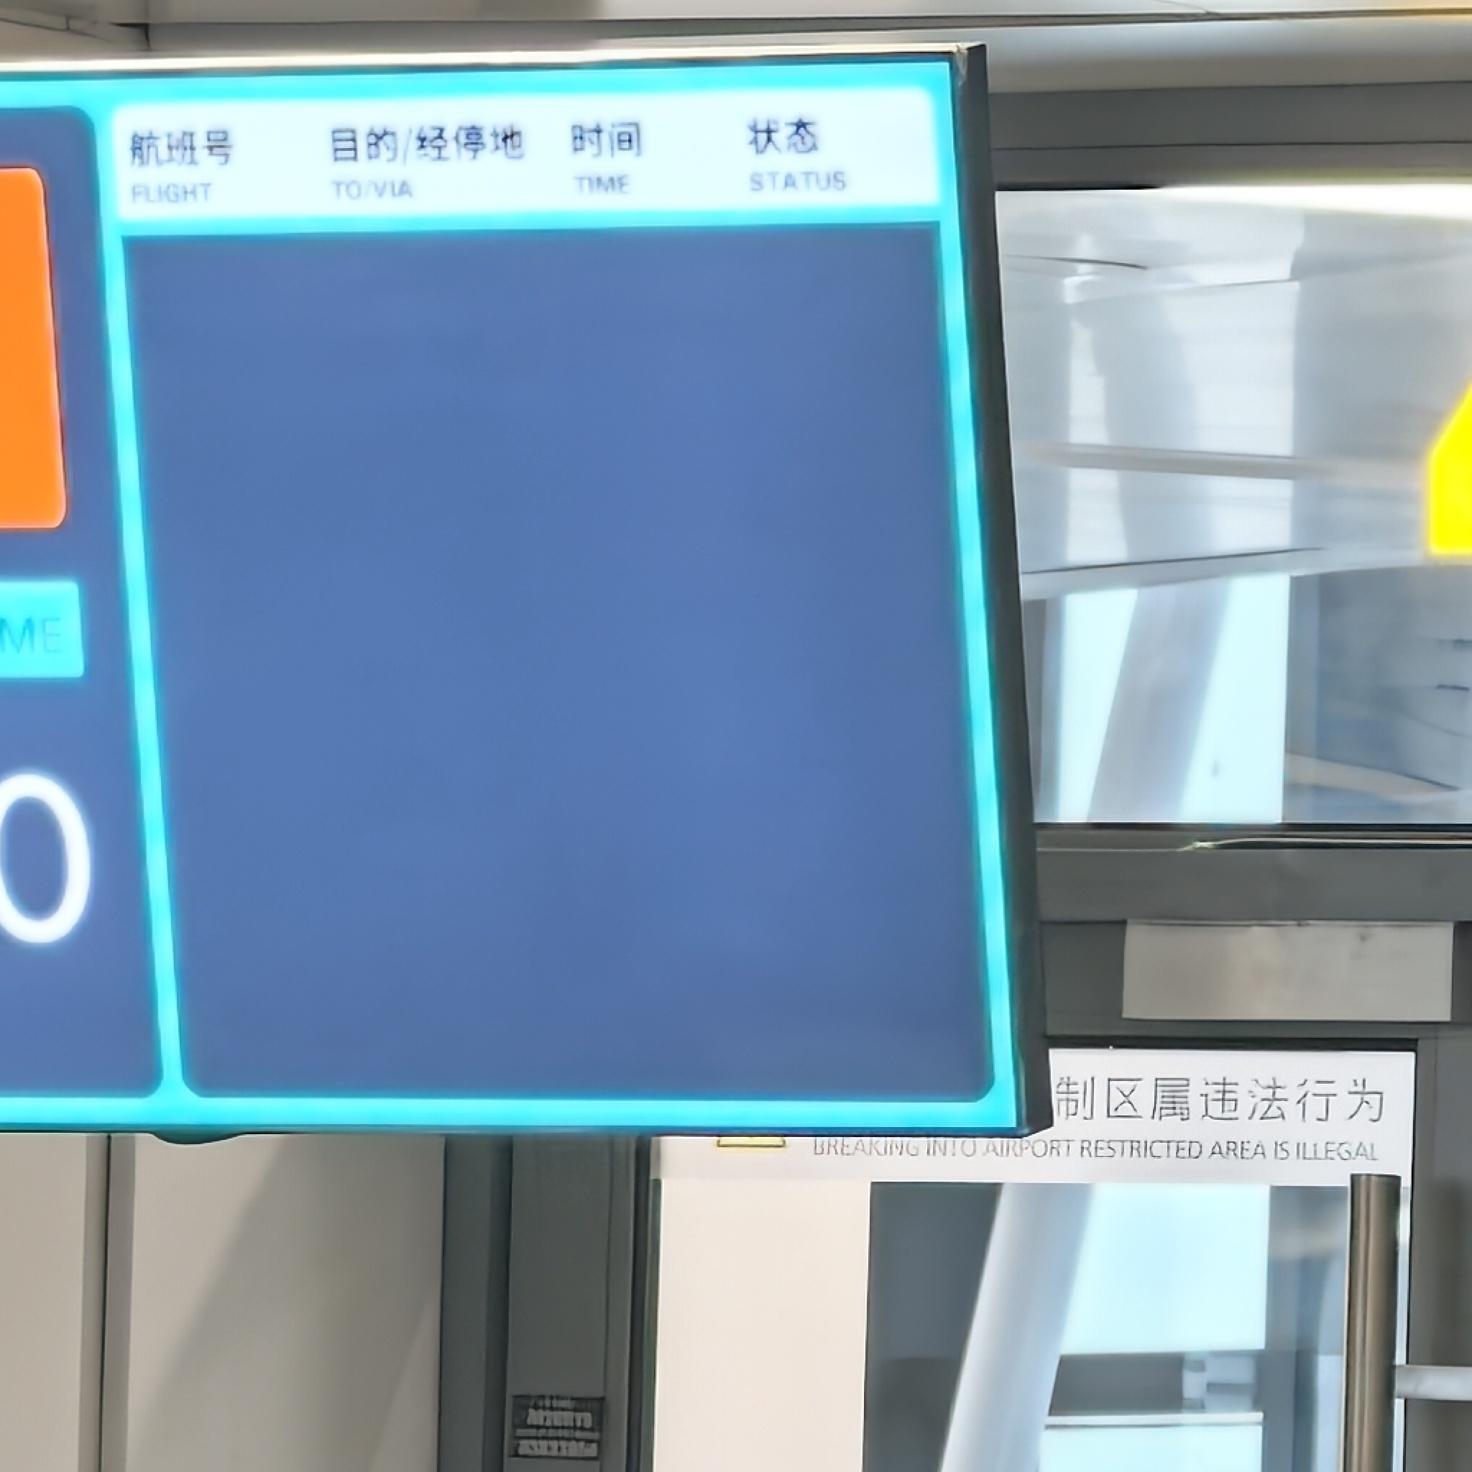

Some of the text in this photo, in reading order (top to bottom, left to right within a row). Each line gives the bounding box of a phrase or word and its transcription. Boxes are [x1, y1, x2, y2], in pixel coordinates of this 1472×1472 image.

[130, 128, 233, 167] 航班号
[331, 124, 525, 164] 目的/经停地
[571, 121, 641, 158] 时间
[747, 117, 819, 154] 状态
[130, 183, 212, 203] FLIGHT
[332, 179, 412, 199] TO/VIA
[574, 175, 631, 195] TIME
[749, 171, 846, 191] STATUS
[1056, 1077, 1384, 1122] 制区属违法行为
[813, 1138, 1379, 1161] BREAKING INTO AIRPORT RESTRICTED AREA IS ILLEGAL
